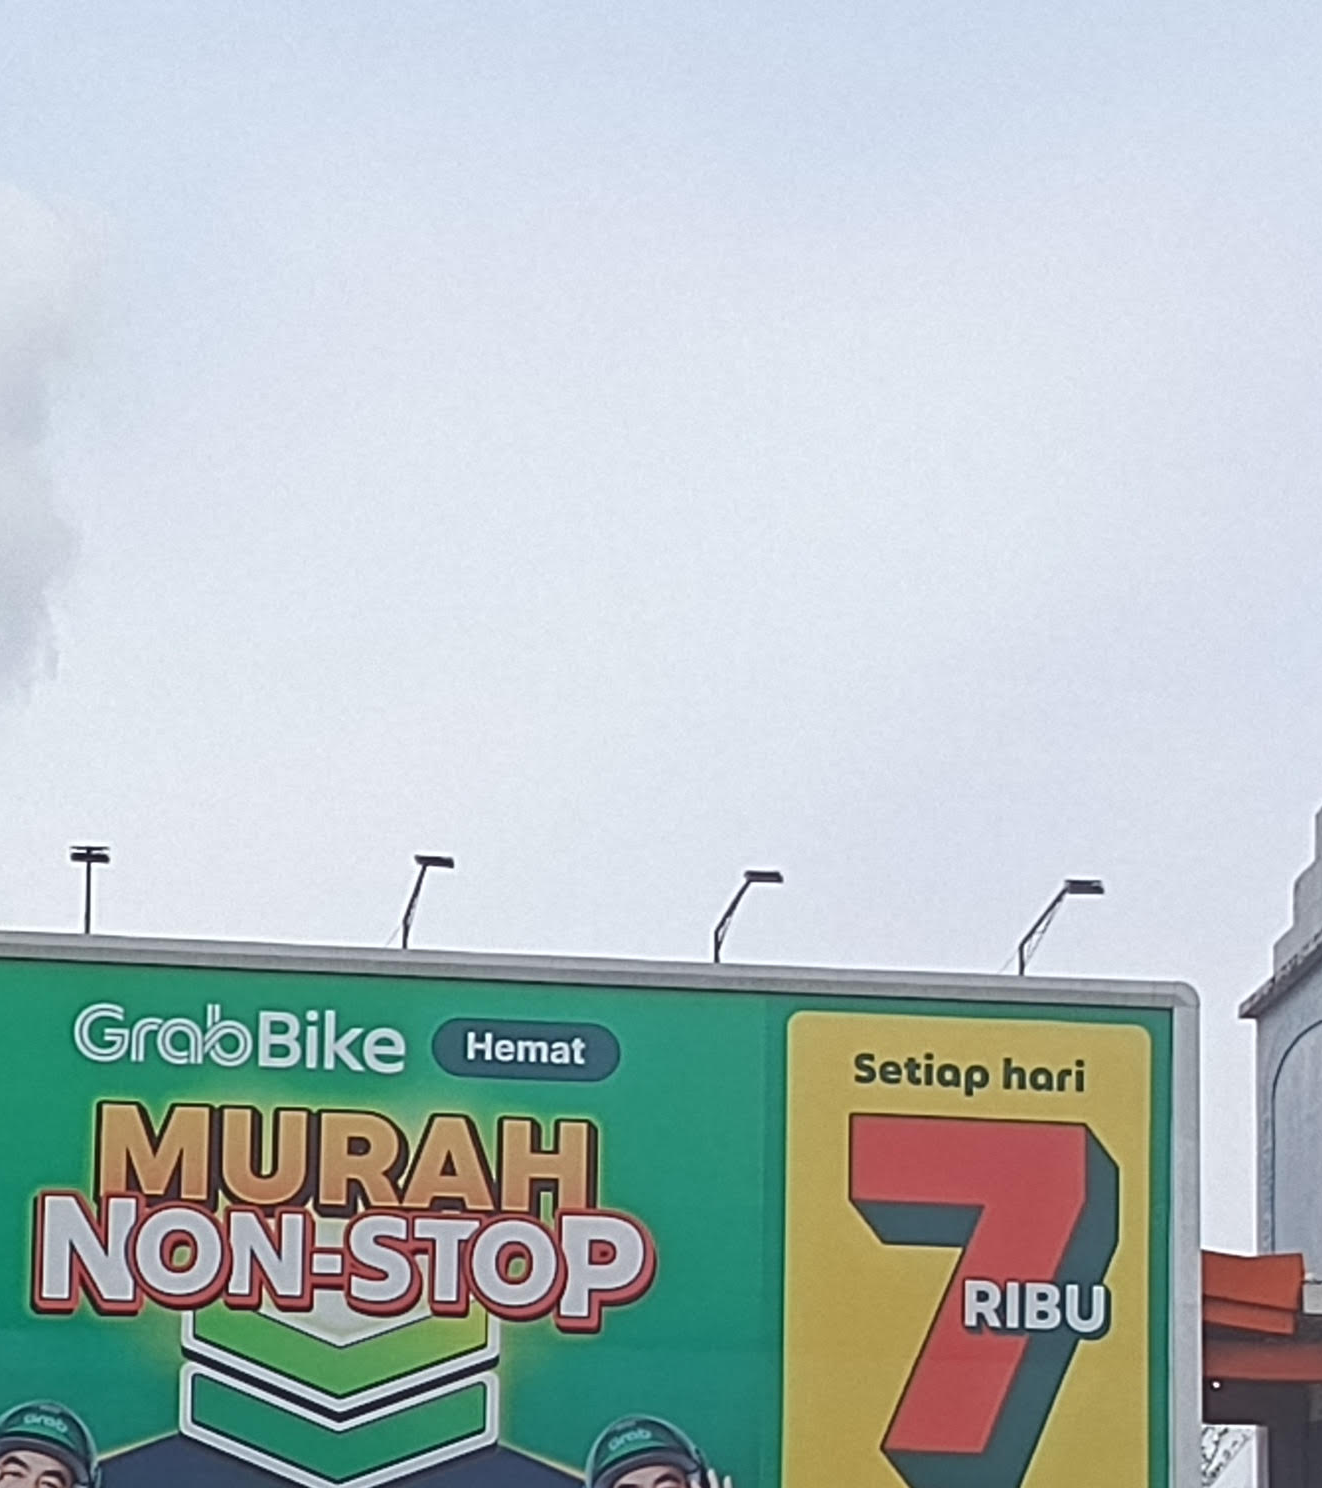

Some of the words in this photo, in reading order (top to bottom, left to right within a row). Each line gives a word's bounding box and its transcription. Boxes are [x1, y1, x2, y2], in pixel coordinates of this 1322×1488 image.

[467, 1030, 587, 1066] Hemat
[854, 1053, 990, 1097] Setiap
[1002, 1057, 1086, 1092] hari
[97, 1101, 597, 1214] MURAH
[35, 1191, 654, 1329] NON-STOP
[963, 1278, 1107, 1335] RIBU
